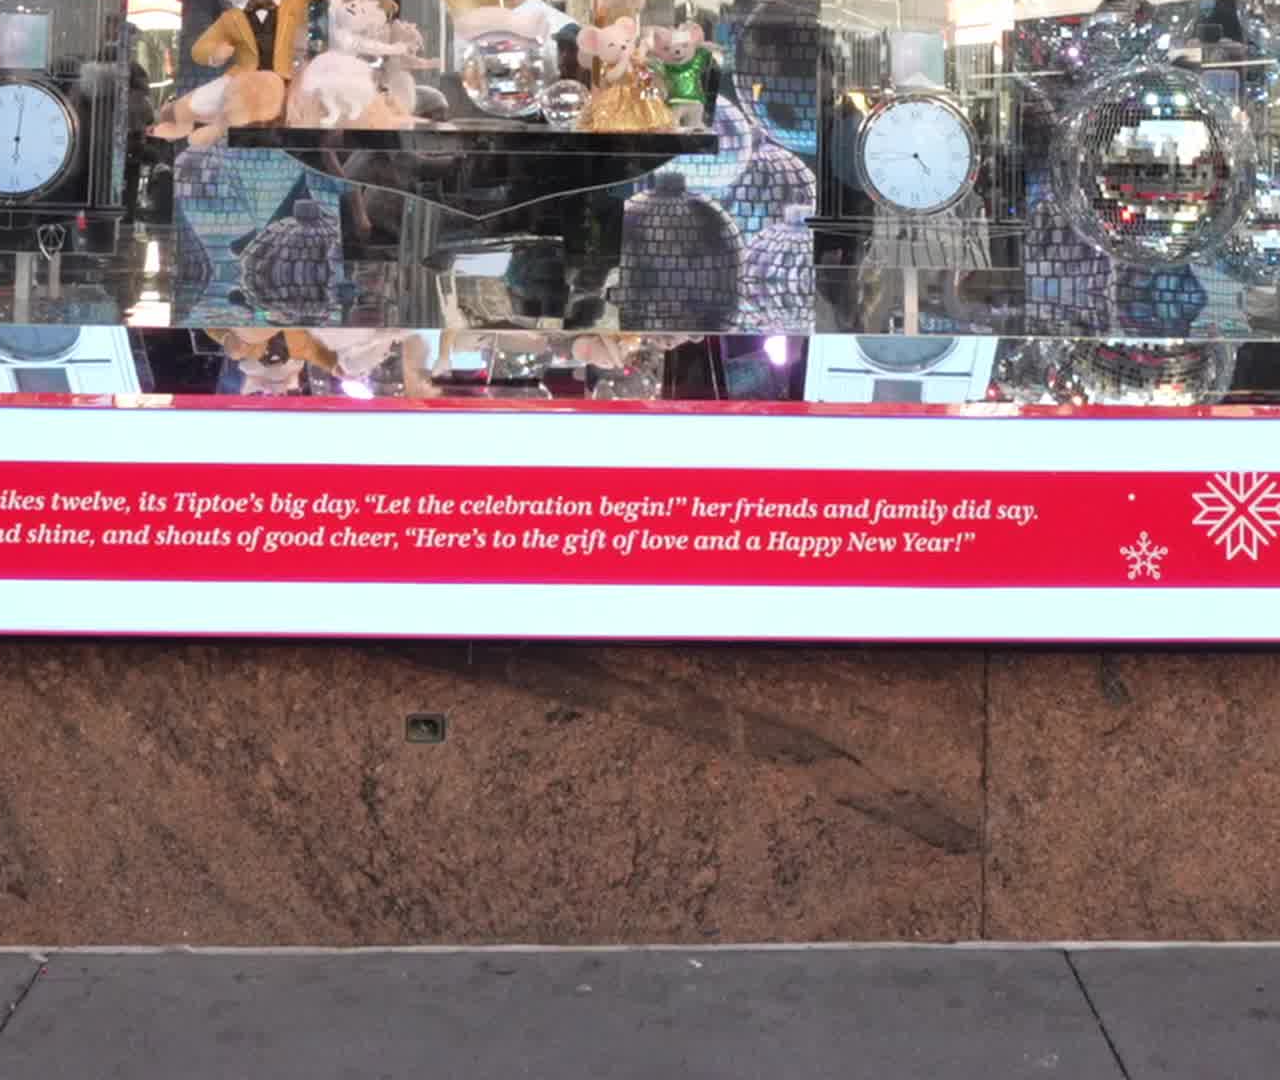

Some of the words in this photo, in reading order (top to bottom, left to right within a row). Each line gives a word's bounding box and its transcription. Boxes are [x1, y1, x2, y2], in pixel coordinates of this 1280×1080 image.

[51, 491, 130, 513] twelve,
[139, 491, 167, 512] its
[174, 492, 264, 518] Tiptoe’s
[270, 493, 308, 519] big
[312, 493, 359, 520] day.
[365, 494, 411, 514] “Let
[417, 494, 455, 514] the
[460, 495, 592, 516] celebration
[600, 496, 687, 522] begin!”
[692, 497, 733, 517] her
[730, 497, 817, 523] friends
[823, 498, 869, 519] and
[870, 499, 948, 525] family
[952, 499, 991, 520] did
[996, 505, 1038, 526] say.
[26, 523, 95, 546] shine,
[102, 525, 150, 544] and
[155, 525, 231, 546] shouts
[237, 526, 264, 552] of
[263, 526, 325, 552] good
[330, 526, 399, 549] cheer,
[493, 530, 516, 548] to
[522, 528, 559, 548] the
[562, 529, 606, 555] gift
[612, 530, 639, 555] of
[641, 530, 688, 550] love
[694, 530, 741, 550] and
[746, 536, 761, 550] a
[767, 531, 842, 557] Happy
[847, 532, 897, 552] New
